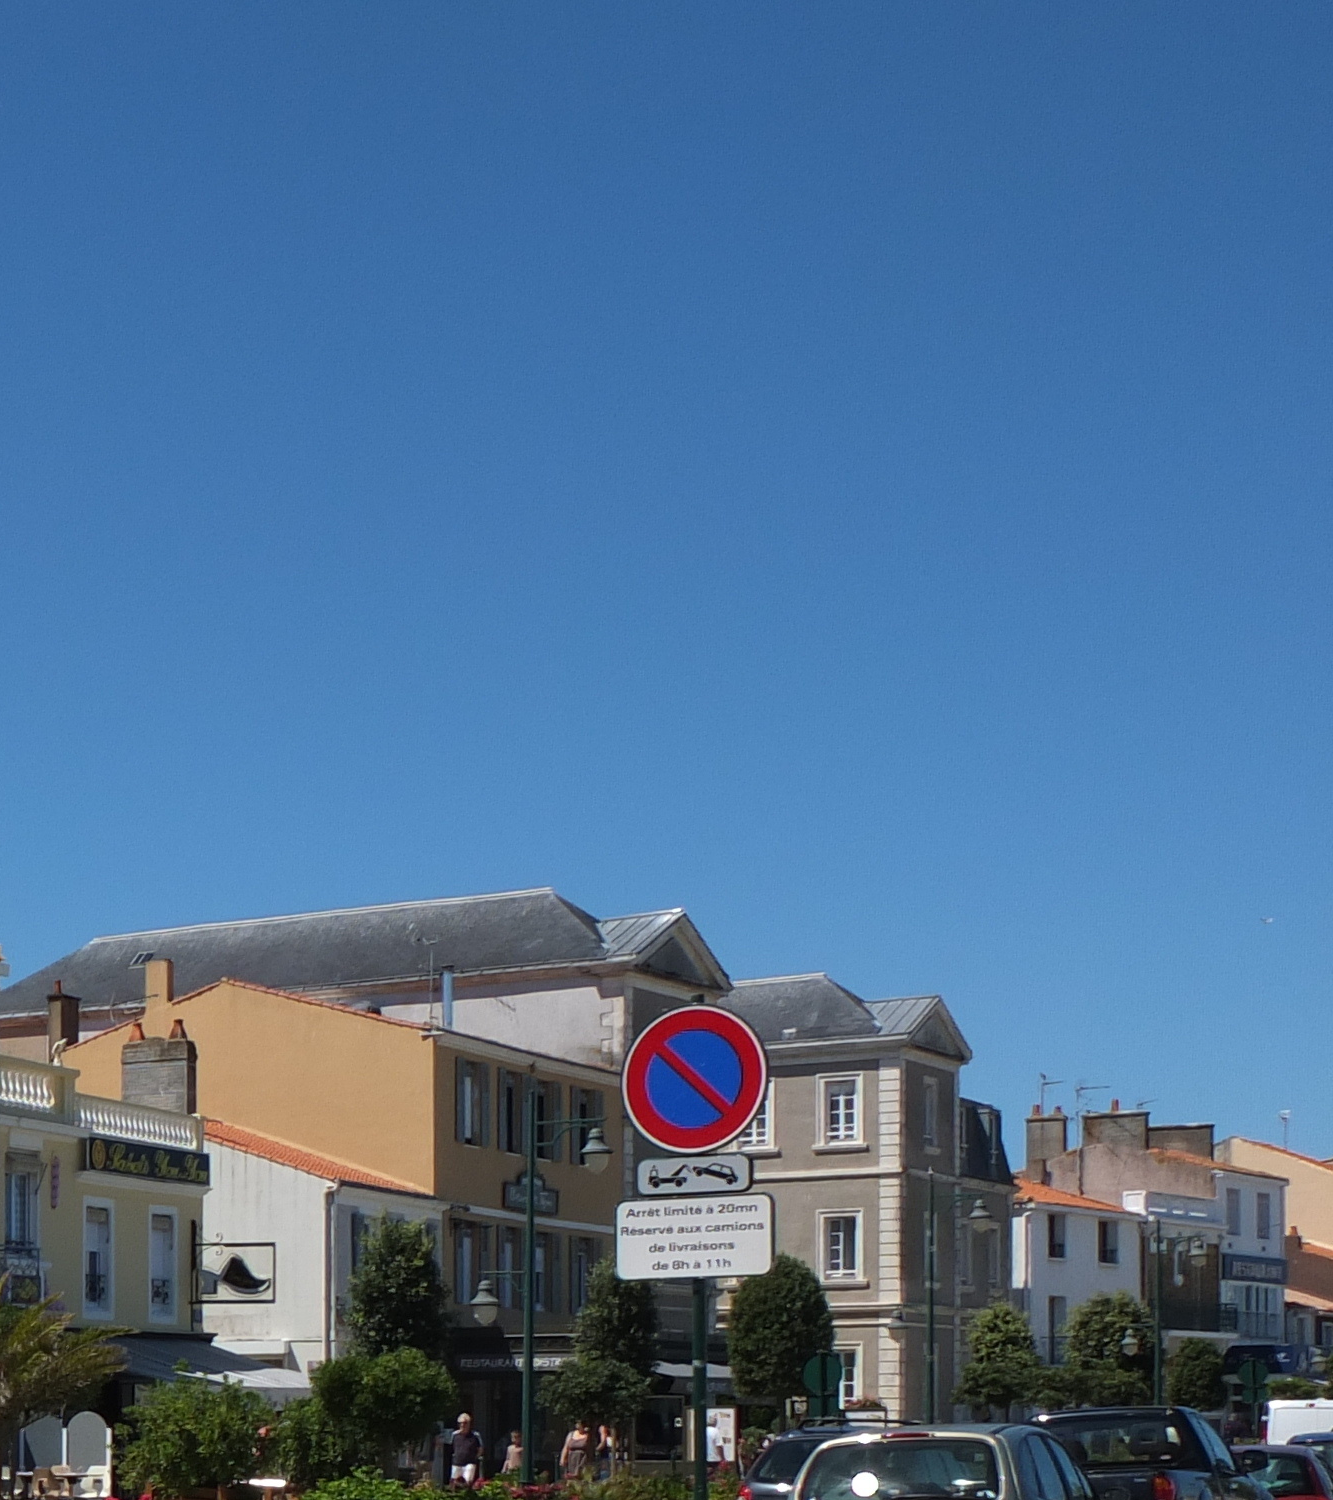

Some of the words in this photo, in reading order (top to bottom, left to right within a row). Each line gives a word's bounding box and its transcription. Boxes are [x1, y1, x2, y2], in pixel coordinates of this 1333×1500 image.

[626, 1207, 661, 1218] Arrêt
[664, 1204, 703, 1216] limité
[706, 1204, 715, 1214] à
[718, 1203, 758, 1214] 20mn
[677, 1226, 702, 1234] aux
[705, 1221, 765, 1232] camions
[649, 1243, 666, 1253] de
[669, 1241, 735, 1251] livraisons
[652, 1261, 669, 1271] de
[672, 1259, 690, 1270] 8h
[706, 1257, 732, 1268] 11h
